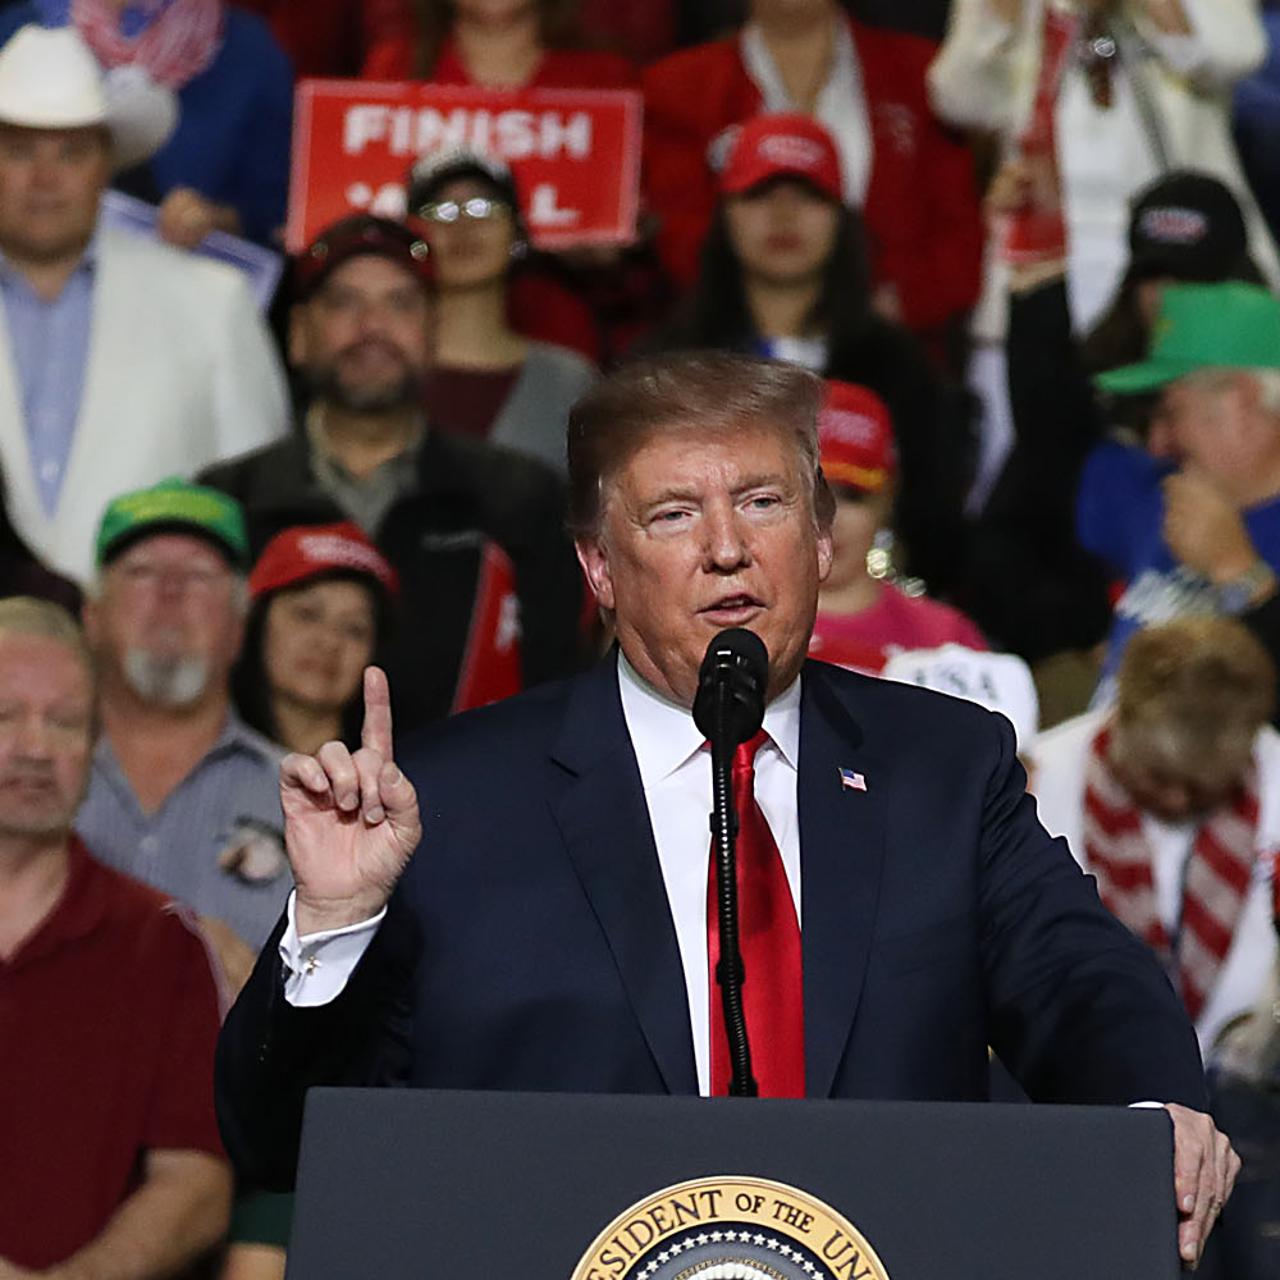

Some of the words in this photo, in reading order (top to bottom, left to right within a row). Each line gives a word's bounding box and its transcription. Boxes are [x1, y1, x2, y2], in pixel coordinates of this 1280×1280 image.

[343, 104, 593, 160] FINISH
[734, 1193, 766, 1214] OF
[773, 1201, 815, 1233] THE
